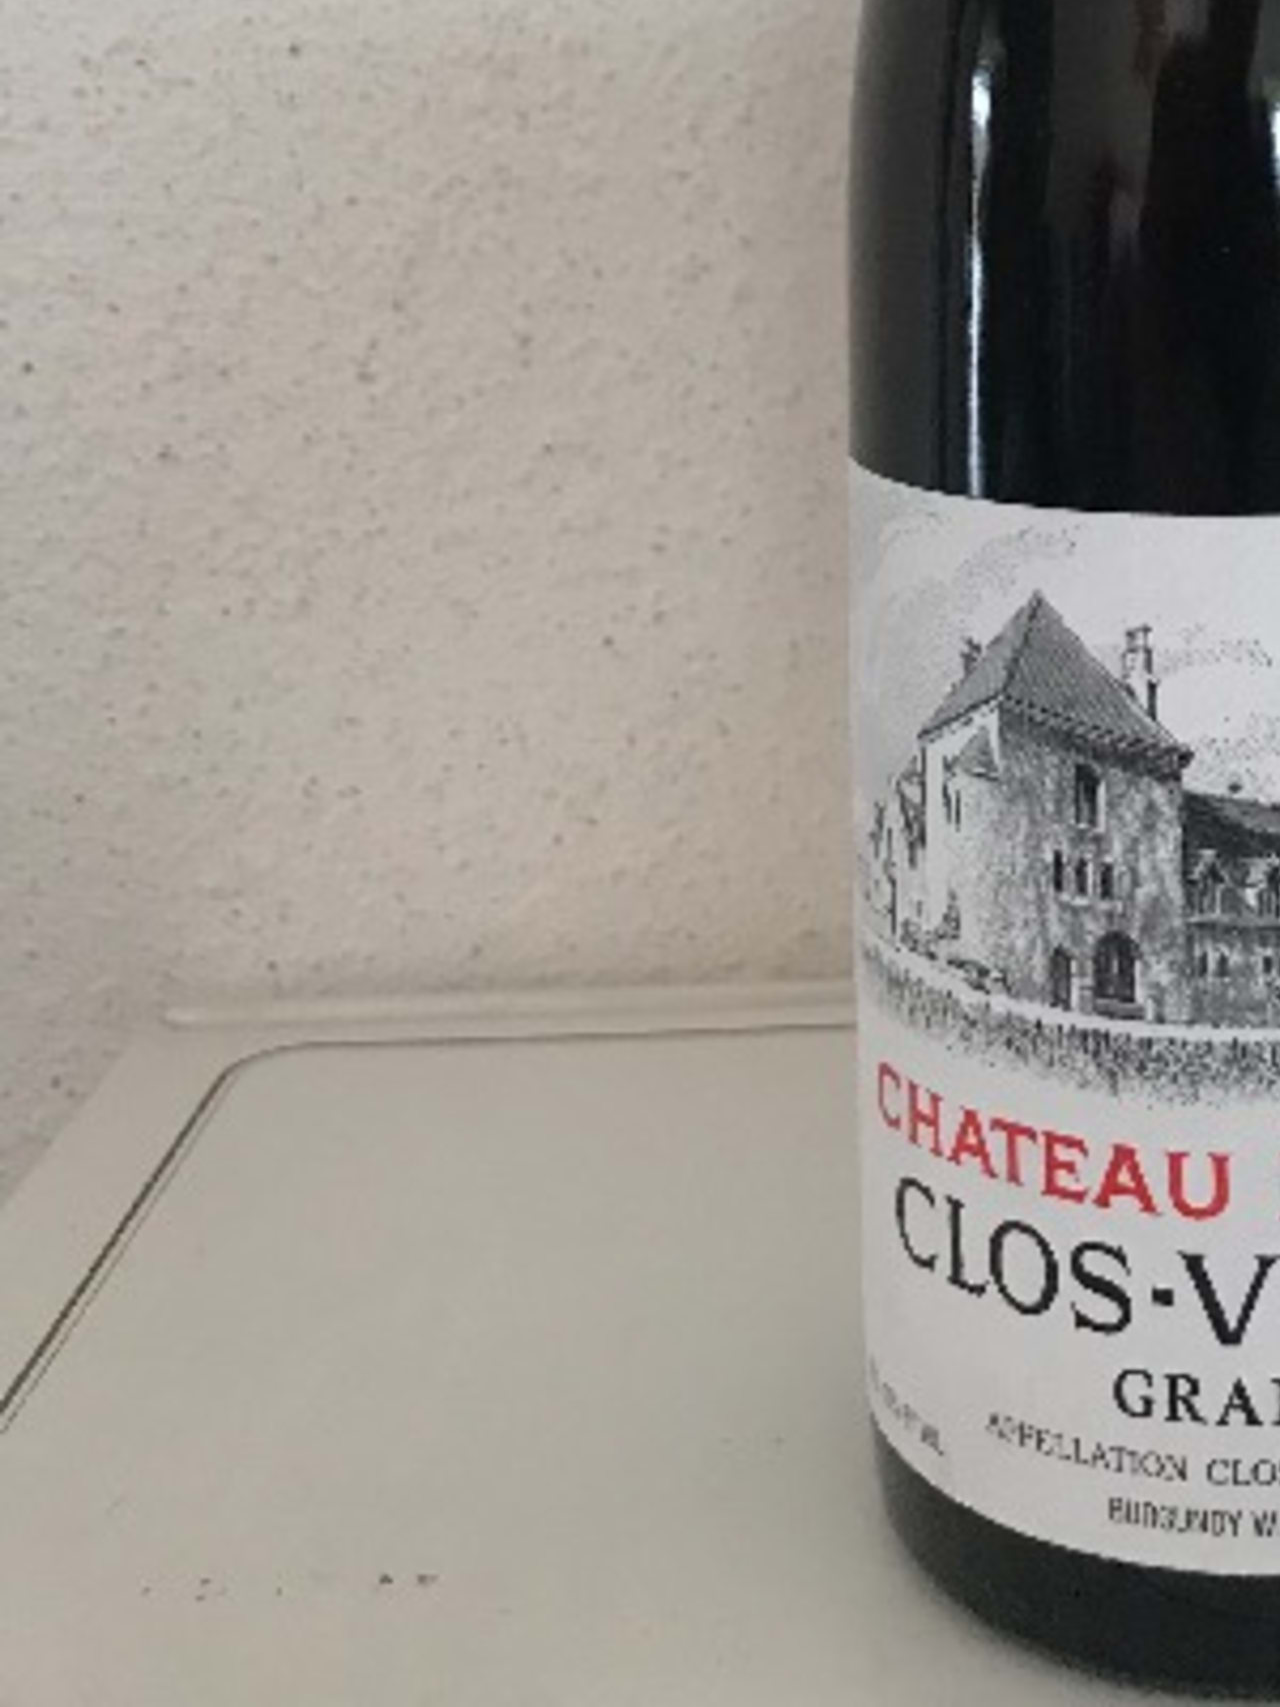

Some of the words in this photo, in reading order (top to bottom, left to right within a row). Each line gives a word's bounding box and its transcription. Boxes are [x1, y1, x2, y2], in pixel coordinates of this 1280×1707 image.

[877, 1062, 1232, 1221] CHATEAU
[985, 1412, 1188, 1482] APPELLATION
[1107, 1496, 1242, 1538] BURGUNDY
